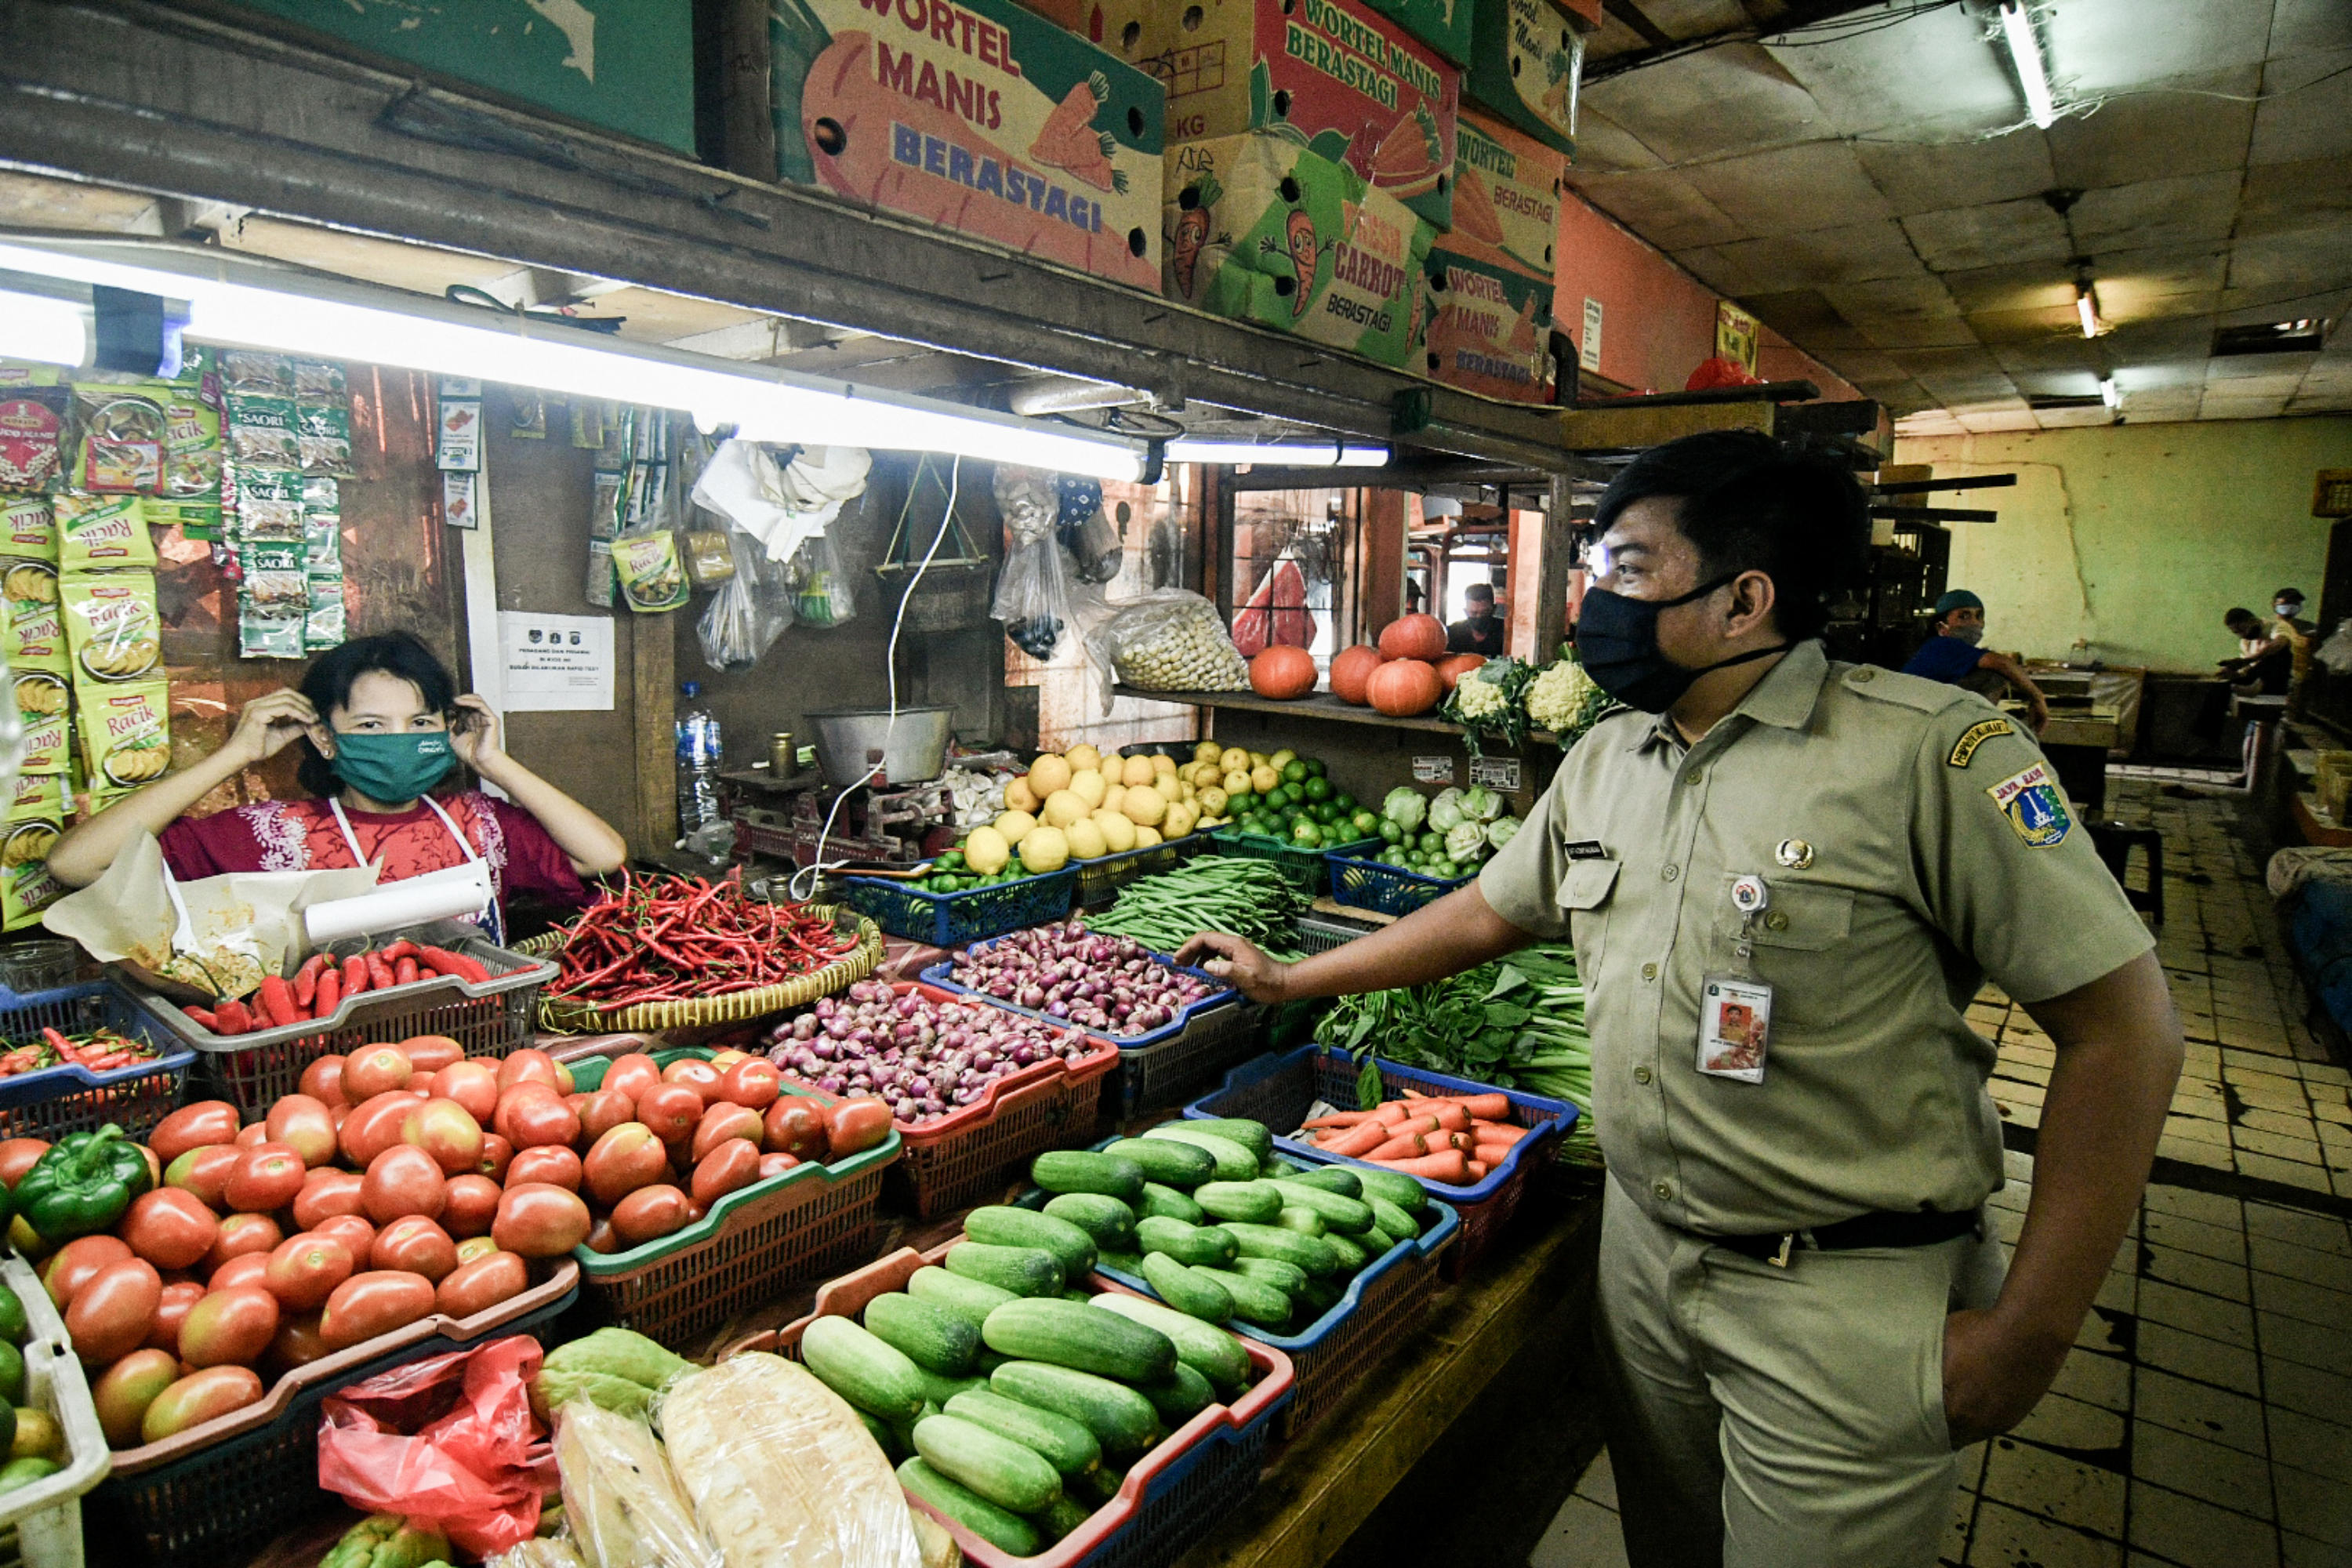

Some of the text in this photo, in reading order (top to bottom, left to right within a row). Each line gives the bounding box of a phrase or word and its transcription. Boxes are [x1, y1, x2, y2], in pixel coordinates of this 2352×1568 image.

[1287, 22, 1397, 111] BERASTAGI
[1305, 0, 1441, 100] WORTEL MANIS
[878, 40, 1001, 130] MANIS
[1177, 115, 1205, 138] KG
[1457, 130, 1516, 180] WORTEL
[893, 121, 1102, 234] BERASTAGI
[1494, 185, 1554, 224] BERASTAGI
[1334, 241, 1406, 303] CARROT
[1448, 267, 1508, 306] WORTEL
[1327, 293, 1392, 333] BERASTAGI
[1456, 307, 1500, 339] MANIS
[243, 412, 284, 426] SAORI
[19, 619, 61, 645] Racik
[107, 706, 157, 737] Racik
[1996, 781, 2020, 799] JAYA
